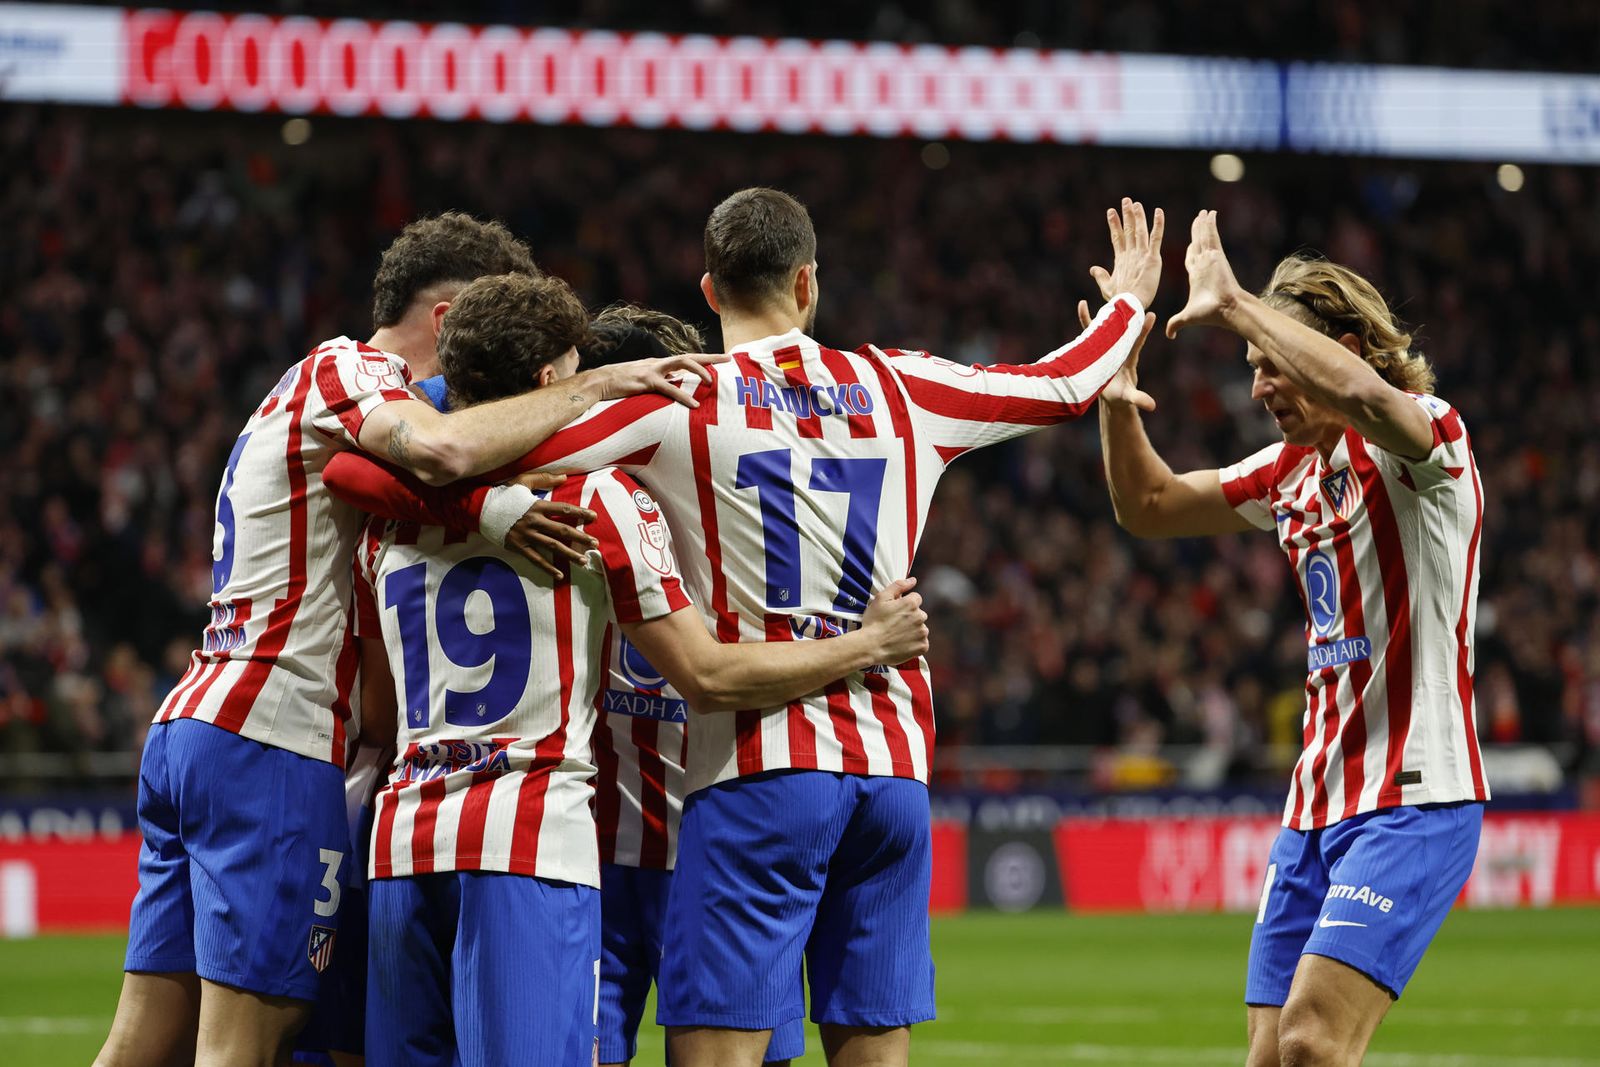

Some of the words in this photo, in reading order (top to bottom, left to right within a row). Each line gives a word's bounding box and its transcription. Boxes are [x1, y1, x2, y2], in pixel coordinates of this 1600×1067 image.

[735, 376, 874, 419] HANCKO
[735, 448, 888, 614] 17
[206, 627, 247, 651] ANDA
[385, 556, 532, 729] 19
[1340, 639, 1368, 660] AIR
[605, 690, 666, 718] YADH
[313, 848, 344, 917] 3
